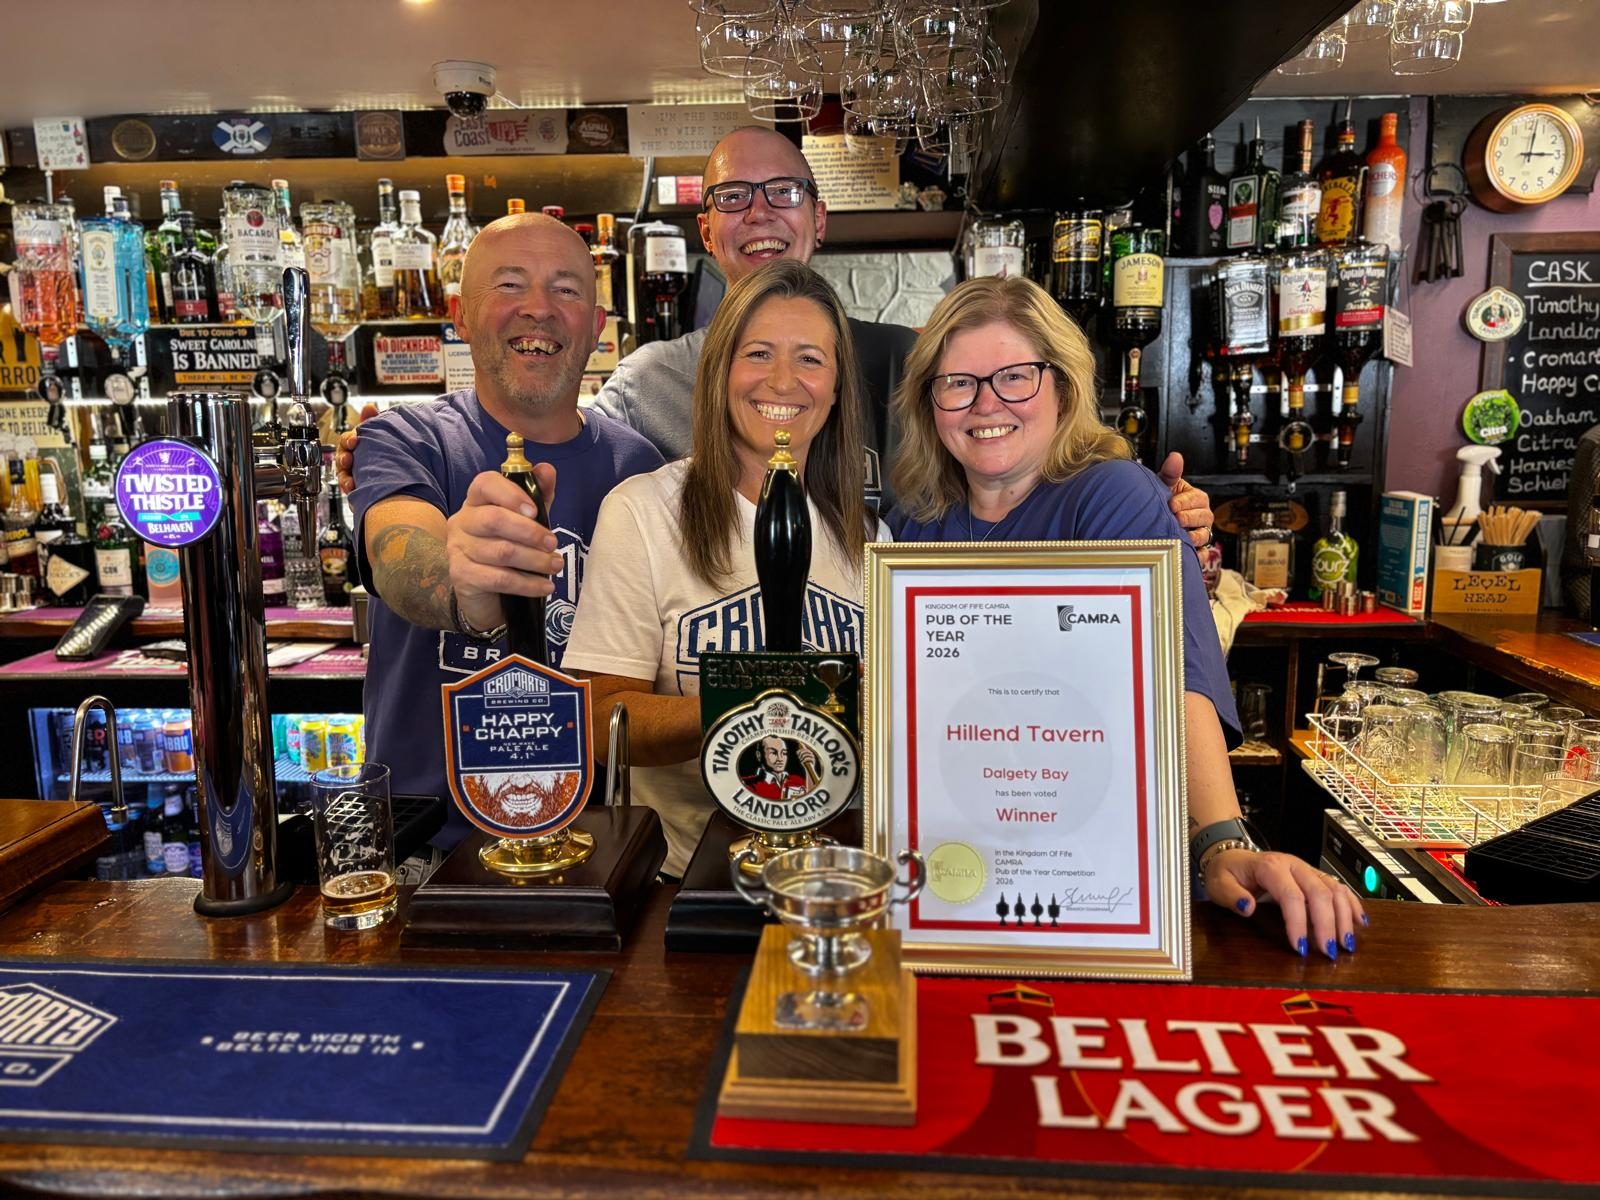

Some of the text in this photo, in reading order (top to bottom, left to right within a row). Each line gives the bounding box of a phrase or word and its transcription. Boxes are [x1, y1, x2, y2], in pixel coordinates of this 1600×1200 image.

[684, 112, 704, 120] THE
[713, 112, 738, 120] BOSS
[495, 122, 518, 142] IPA
[677, 127, 704, 137] WIFE
[1511, 125, 1518, 135] 11
[1524, 121, 1535, 131] 12
[1542, 125, 1546, 134] 1
[455, 130, 491, 148] Coast
[1499, 137, 1509, 147] 10
[1550, 135, 1558, 145] 2
[1495, 151, 1502, 160] 9
[1554, 150, 1561, 159] 3
[1498, 167, 1505, 176] 8
[1548, 167, 1555, 175] 4
[1508, 177, 1516, 187] 7
[1521, 181, 1528, 191] 6
[1536, 177, 1544, 187] 5
[237, 229, 274, 238] BACARDI
[1120, 256, 1162, 270] JAMESON
[1528, 260, 1592, 283] CASK
[1224, 280, 1241, 298] JACK
[1524, 294, 1600, 320] Timothy
[170, 338, 207, 351] SWEET
[376, 339, 440, 352] NO DICKHEADS
[172, 351, 260, 370] IS BANNED
[1, 366, 41, 386] RRO
[1521, 373, 1577, 397] Happy
[20, 407, 48, 418] NEEDS
[1519, 408, 1598, 428] Oakham
[9, 422, 20, 435] TO
[1480, 426, 1508, 438] Citra
[1517, 434, 1577, 452] Citra
[121, 474, 213, 493] TWISTED
[129, 493, 206, 511] THISTLE
[147, 521, 194, 535] BELHAVEN
[1464, 593, 1508, 603] HEAD
[926, 614, 1013, 625] PUB OF THE
[1068, 613, 1121, 624] CAMRA
[926, 630, 965, 642] YEAR
[926, 647, 960, 658] 2026
[706, 658, 809, 676] CHAMPION
[487, 671, 548, 695] CROMARTY
[706, 674, 807, 690] CLUB MEMBER
[988, 688, 1003, 696] This
[1004, 688, 1009, 696] is
[1020, 688, 1043, 697] certify
[1044, 688, 1060, 696] that
[491, 697, 529, 705] BREWING
[481, 712, 555, 727] HAPPY
[475, 726, 563, 740] CHAPPY
[741, 728, 796, 745] CHAMPIONSHIP
[946, 724, 1105, 743] Hillend Tavern
[712, 713, 765, 774] TIMOTHY
[791, 713, 852, 777] TAYLOR'S
[983, 767, 1069, 782] Dalgety Bay
[995, 789, 1057, 798] has been voted
[732, 788, 831, 819] LANDLORD
[733, 805, 745, 816] THE
[745, 812, 771, 825] CLASSIC
[790, 818, 802, 826] ALE
[995, 807, 1058, 823] Winner
[1015, 850, 1048, 858] Kingdom
[1051, 869, 1096, 877] Competition
[232, 1031, 401, 1045] BEER WORTH
[215, 1042, 401, 1056] BELIEVING IN
[970, 1013, 1436, 1083] BELTER
[1031, 1075, 1422, 1144] LAGER
